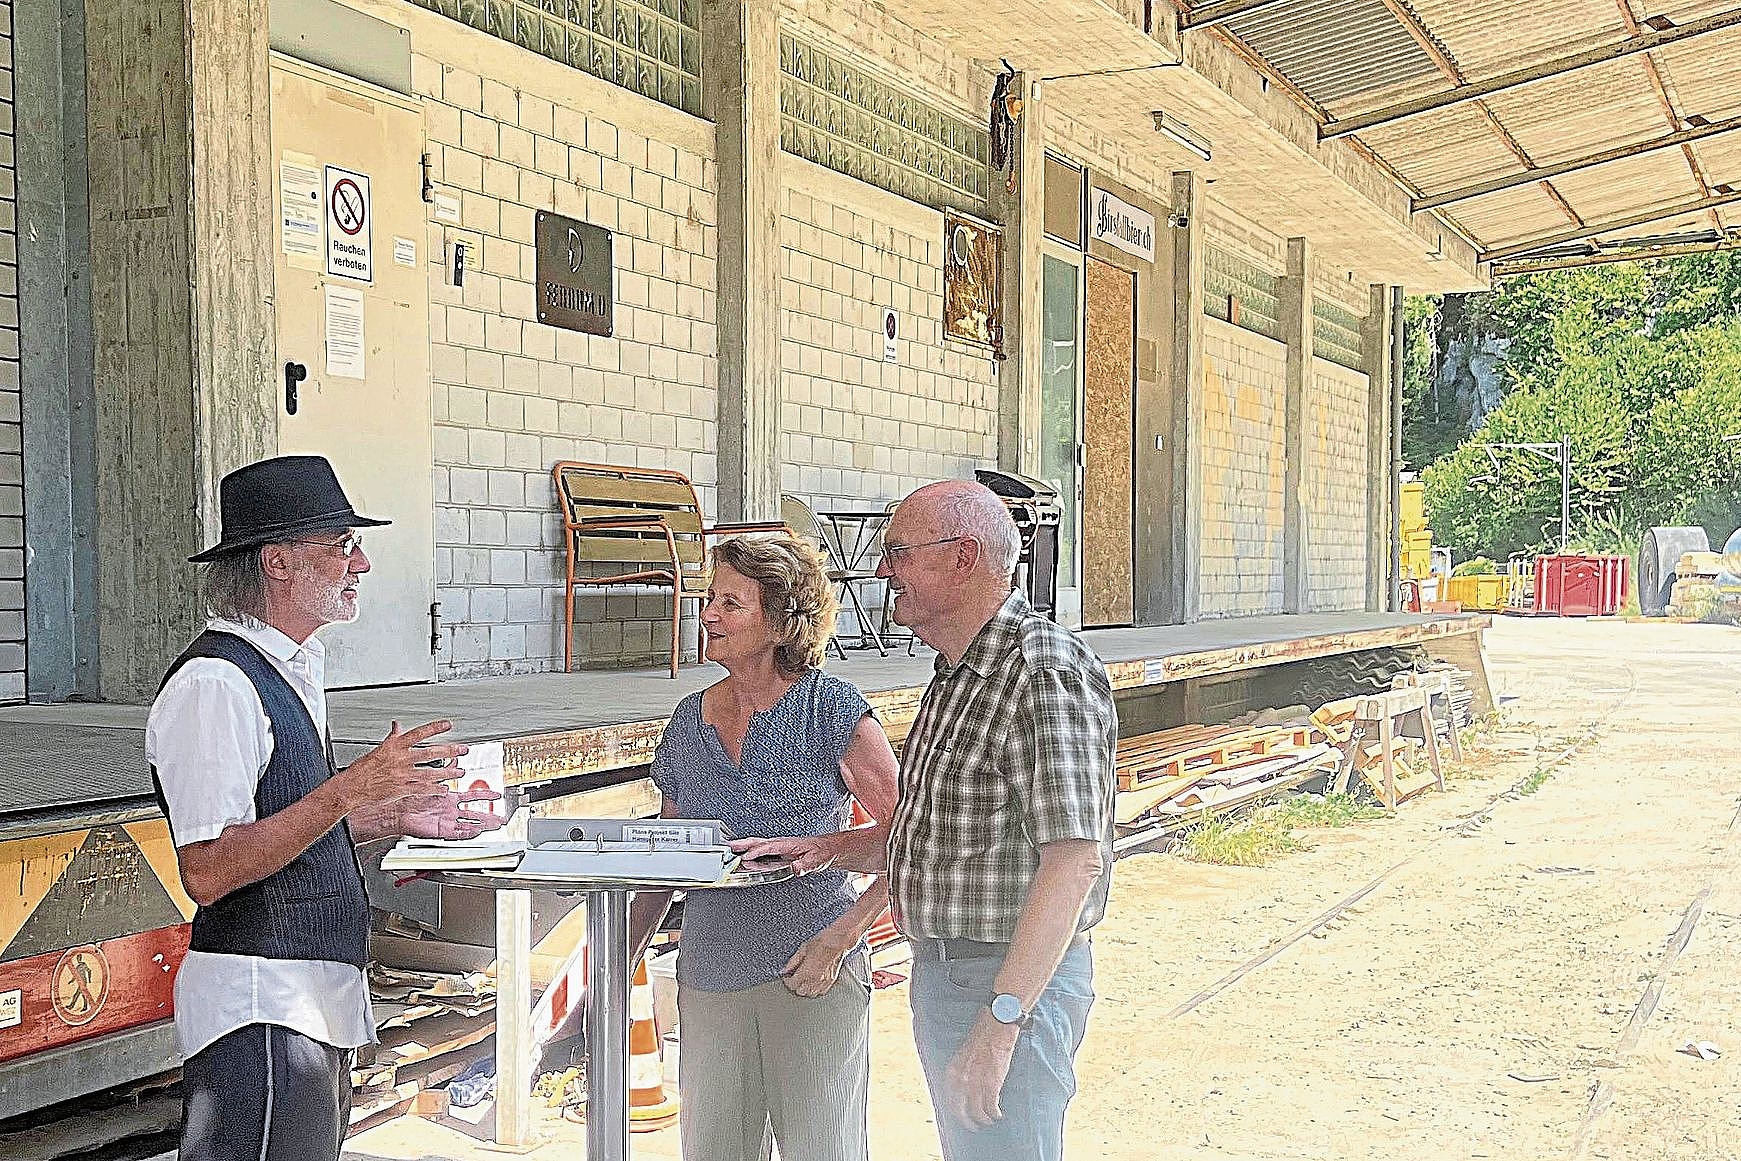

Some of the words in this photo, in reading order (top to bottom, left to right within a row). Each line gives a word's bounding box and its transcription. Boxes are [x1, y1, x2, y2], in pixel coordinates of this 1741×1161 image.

[333, 239, 366, 257] Rauchen
[333, 257, 367, 271] verboten
[3, 997, 16, 1006] AG
